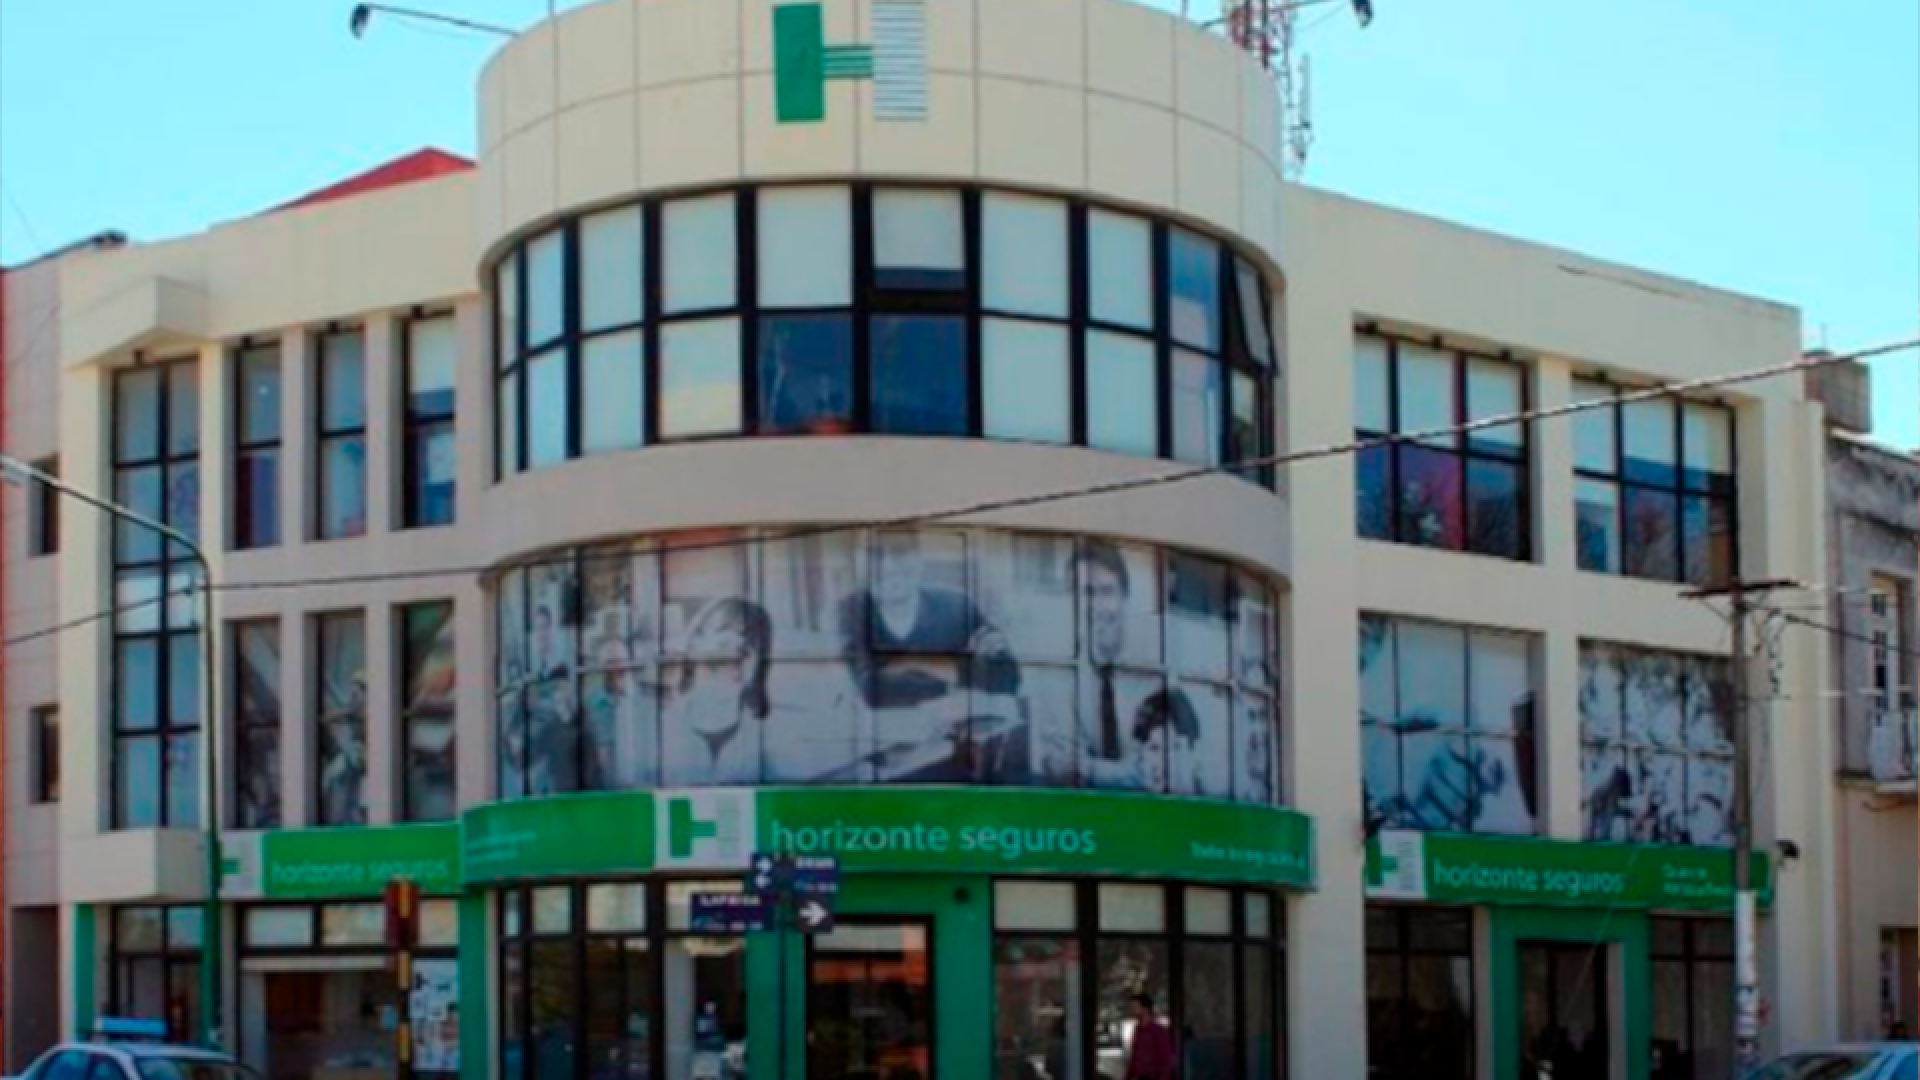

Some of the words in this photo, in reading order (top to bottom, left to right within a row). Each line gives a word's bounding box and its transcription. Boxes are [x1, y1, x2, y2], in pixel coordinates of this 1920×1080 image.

[771, 820, 948, 853] horizonte
[960, 826, 1096, 859] seguros
[271, 860, 364, 884] horizonte
[368, 858, 449, 881] seguros
[1434, 861, 1536, 889] horizonte
[1543, 870, 1624, 897] seguros
